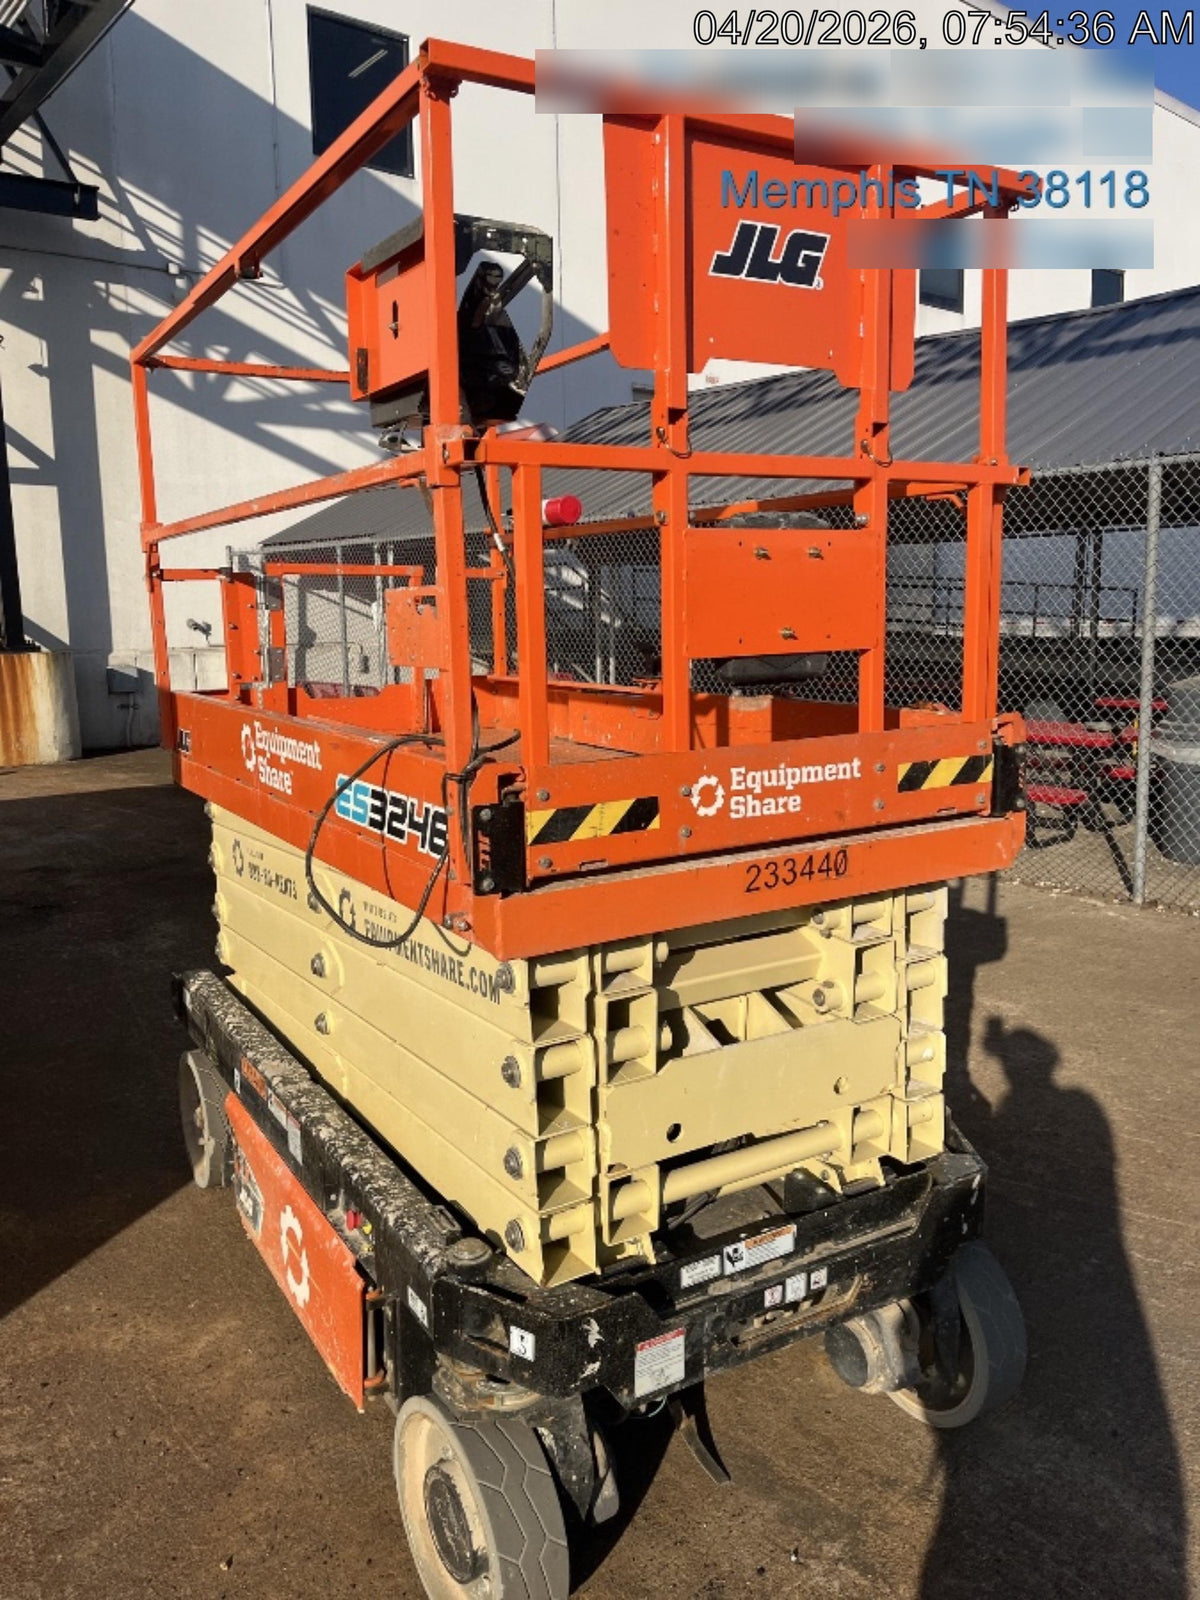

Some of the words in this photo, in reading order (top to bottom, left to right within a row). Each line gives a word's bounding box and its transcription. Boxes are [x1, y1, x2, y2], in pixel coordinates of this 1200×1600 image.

[709, 220, 831, 289] JLG
[254, 720, 322, 770] Equipment
[257, 755, 292, 795] Share
[730, 757, 861, 794] Equipment
[335, 774, 449, 860] ES3246
[729, 794, 802, 819] Share
[745, 849, 848, 893] 233440
